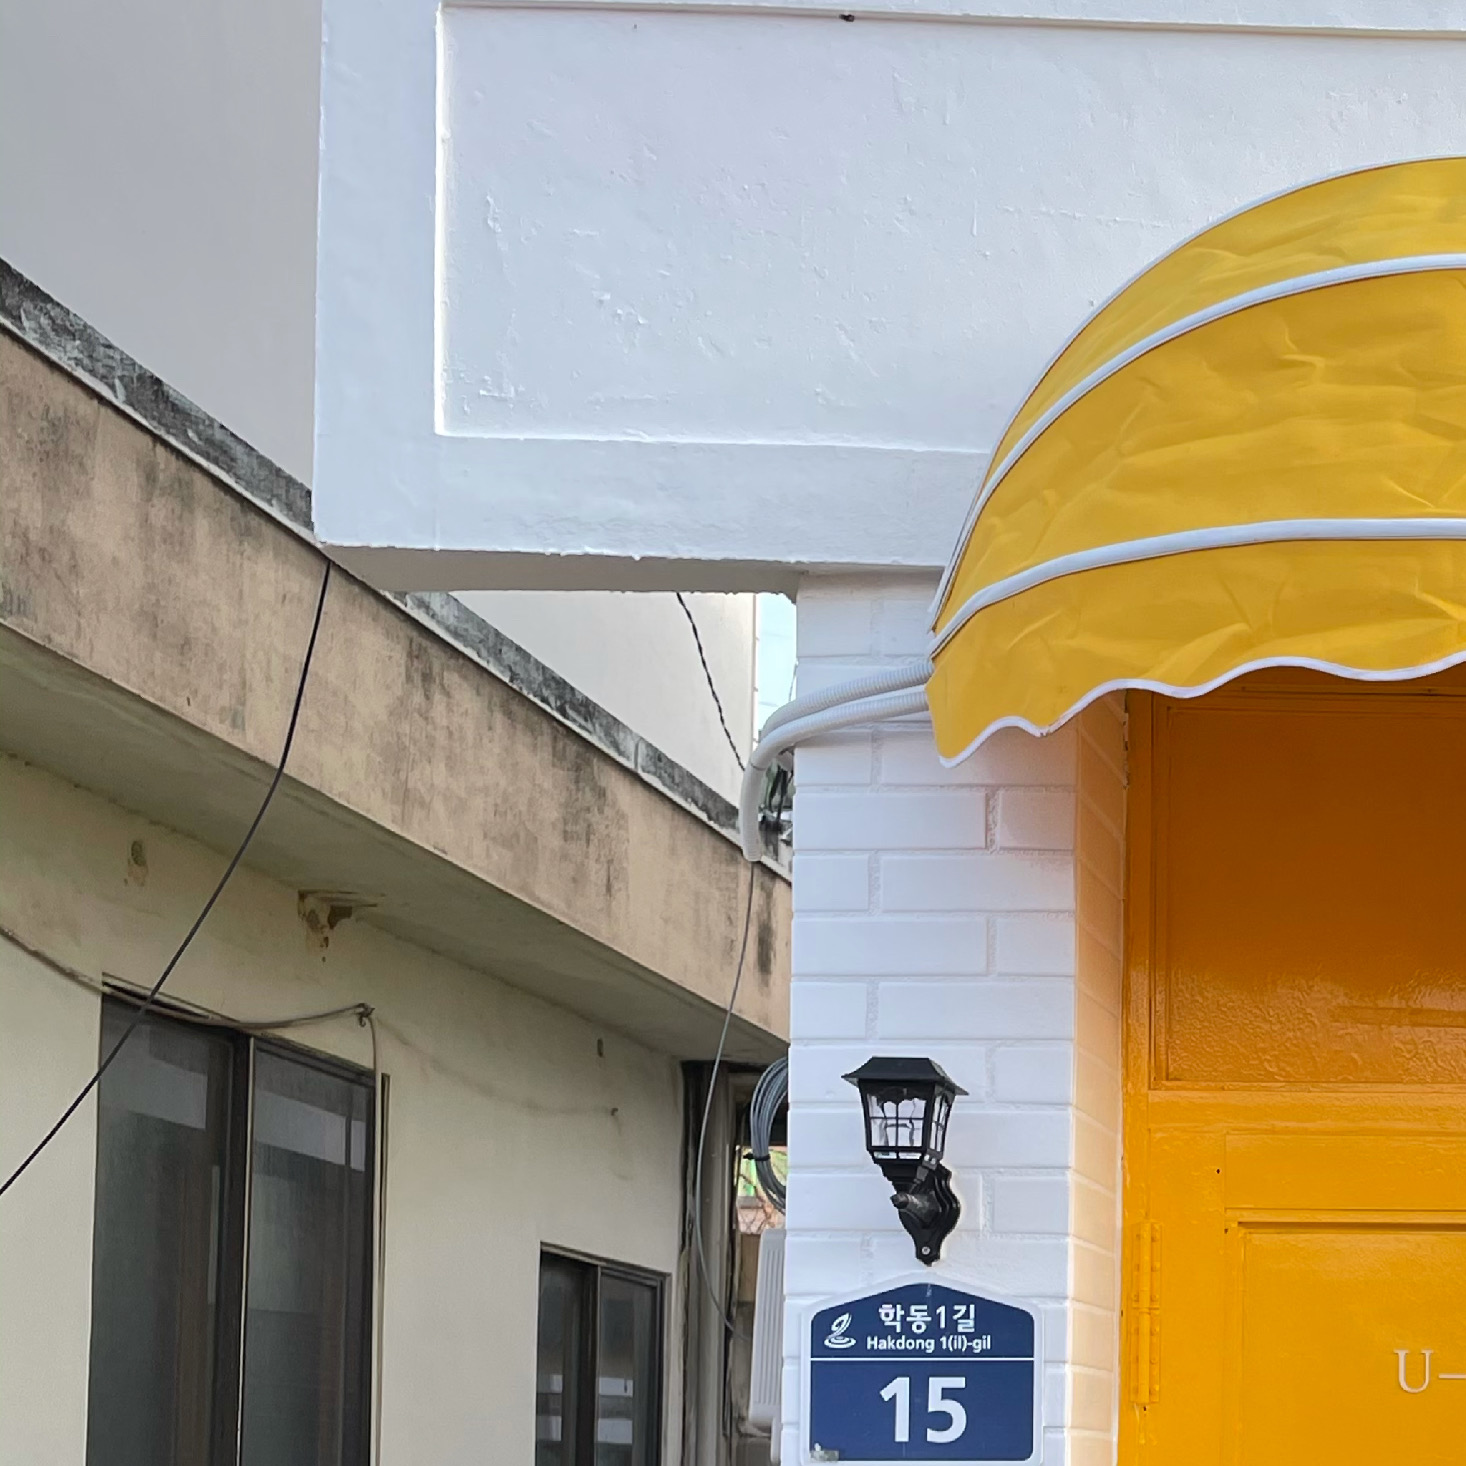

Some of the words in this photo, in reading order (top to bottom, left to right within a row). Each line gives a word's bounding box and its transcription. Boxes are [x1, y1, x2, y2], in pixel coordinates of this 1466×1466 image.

[878, 1304, 975, 1334] 학동1길
[866, 1335, 935, 1353] Hakdong
[940, 1335, 991, 1353] 1(il)-gil
[879, 1376, 968, 1444] 15
